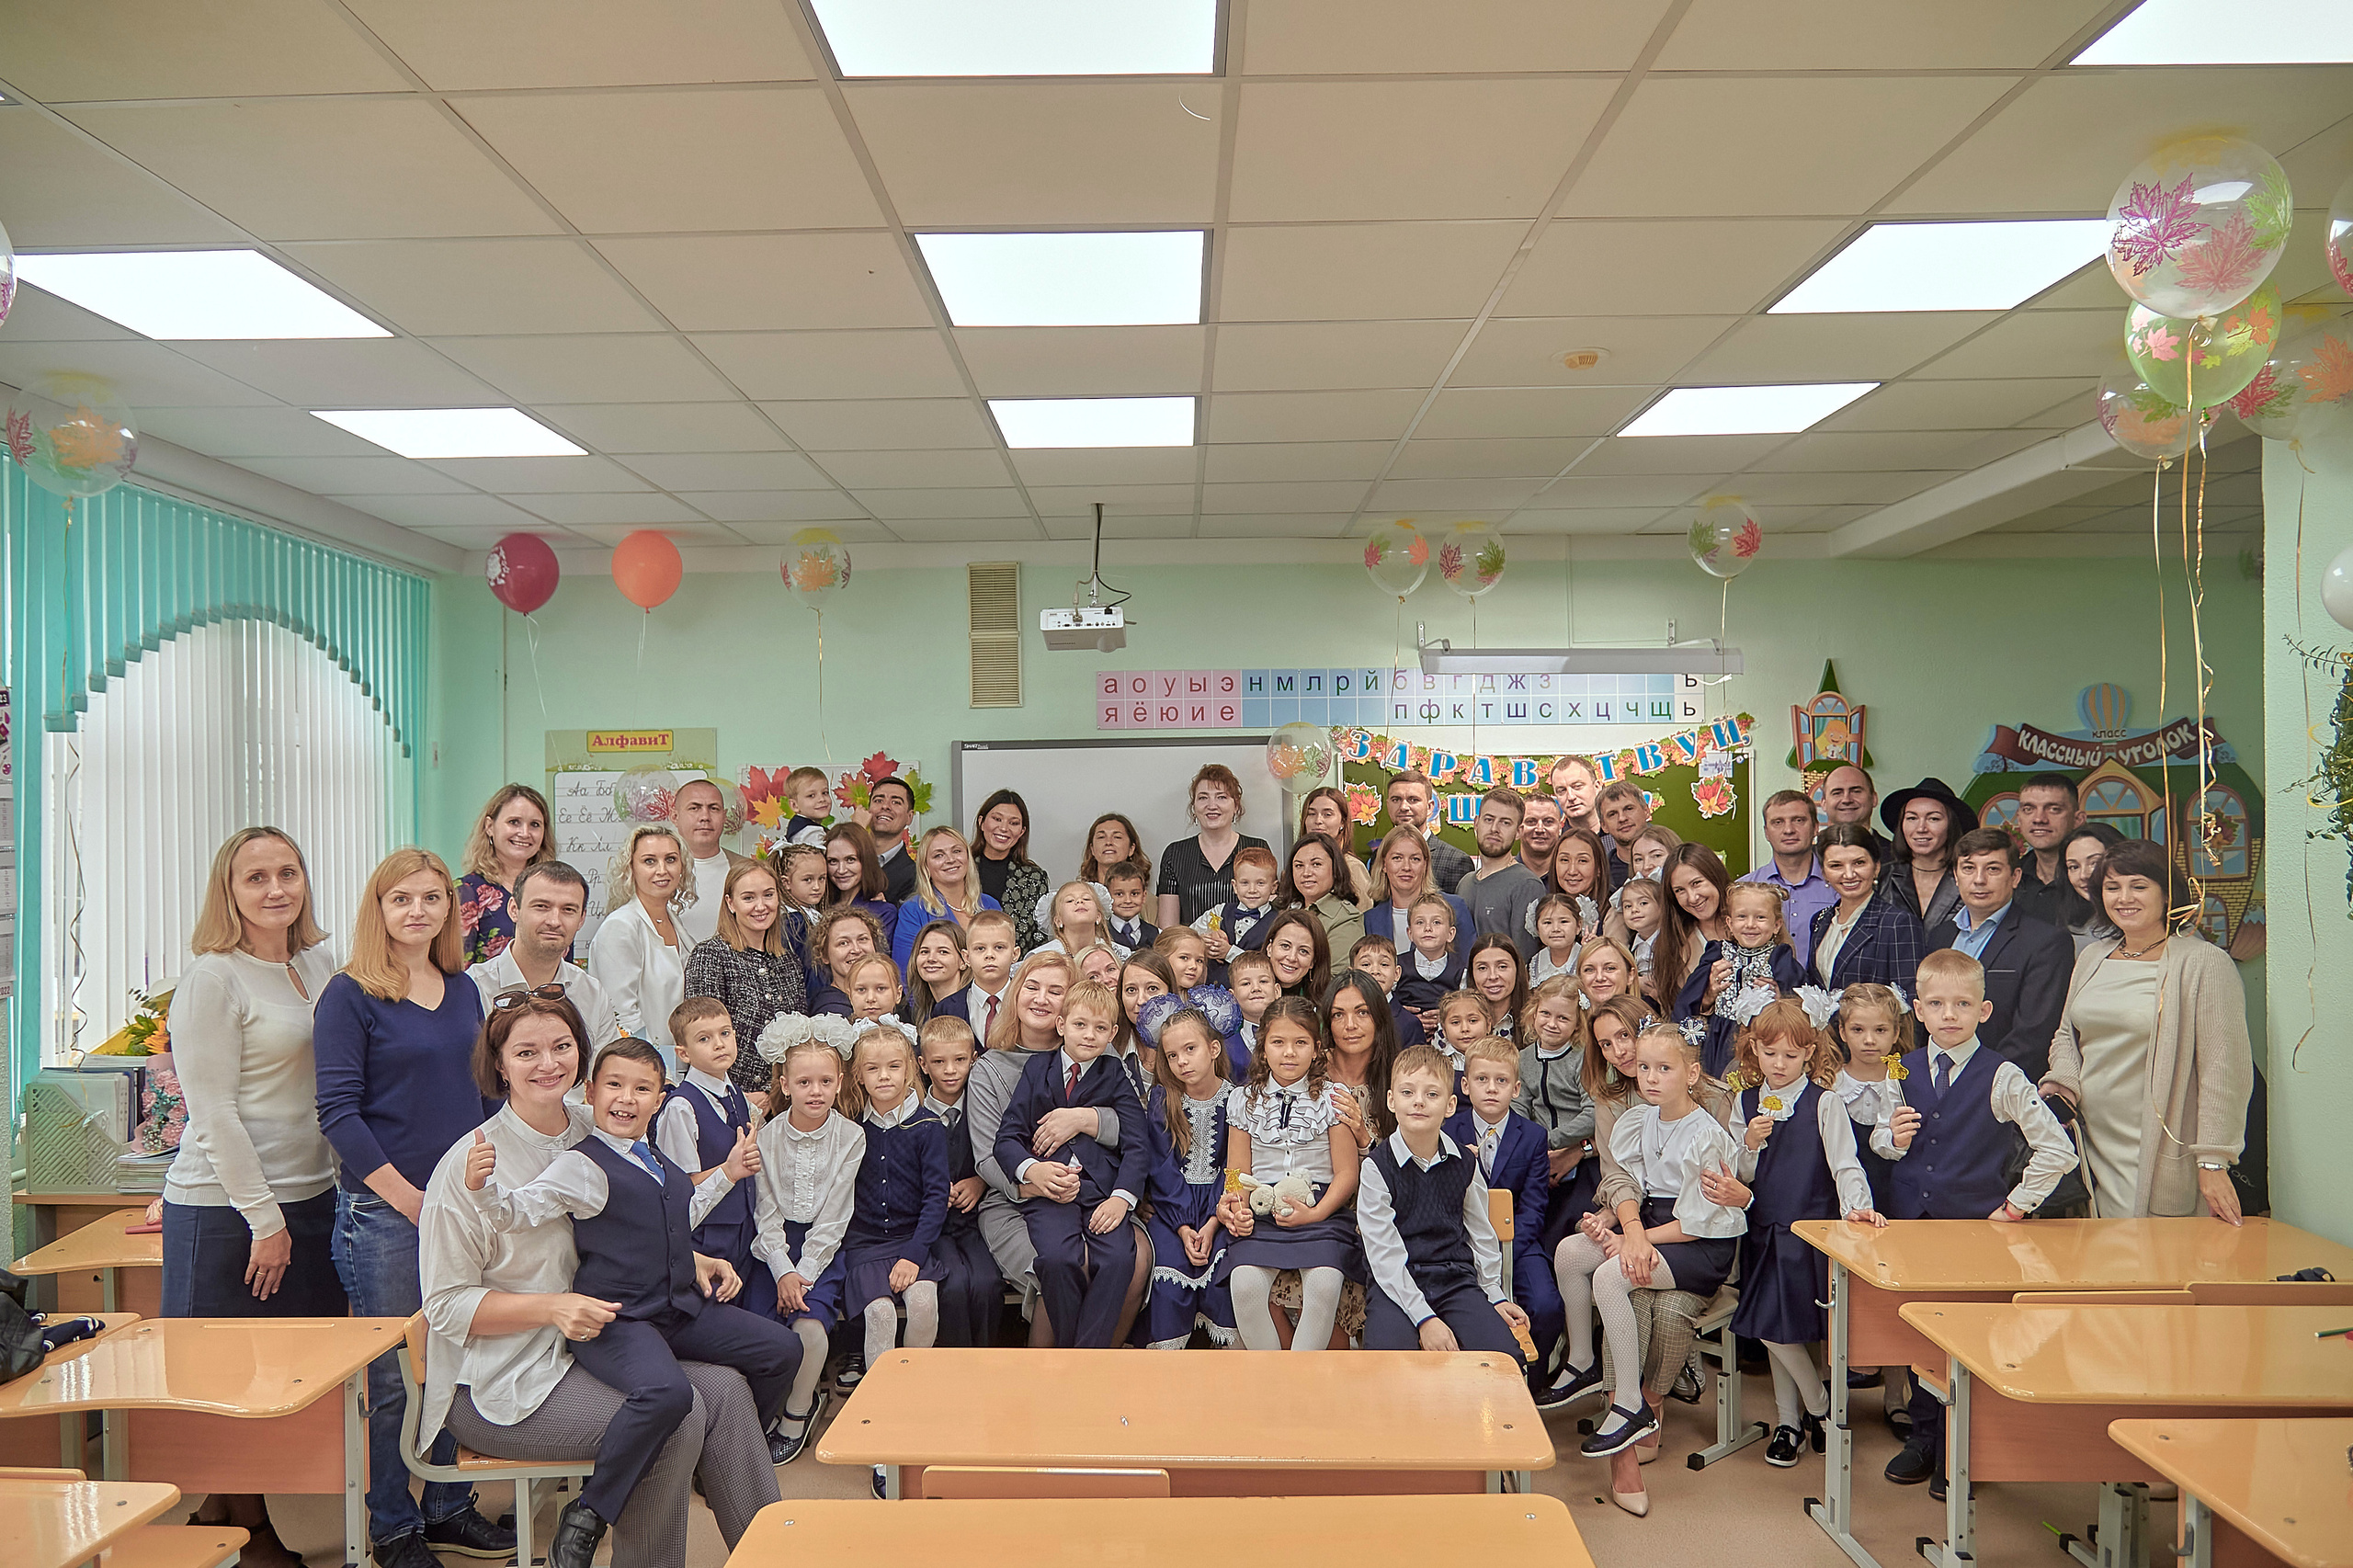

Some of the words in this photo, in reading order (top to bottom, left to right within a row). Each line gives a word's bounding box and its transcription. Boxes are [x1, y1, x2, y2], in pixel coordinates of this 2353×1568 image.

[1346, 715, 1752, 788] ЗДРАВТВУЙ,
[2018, 729, 2103, 767] КЛАССНЫЙ
[2118, 722, 2197, 766] УГОЛОК
[598, 806, 623, 823] Ж
